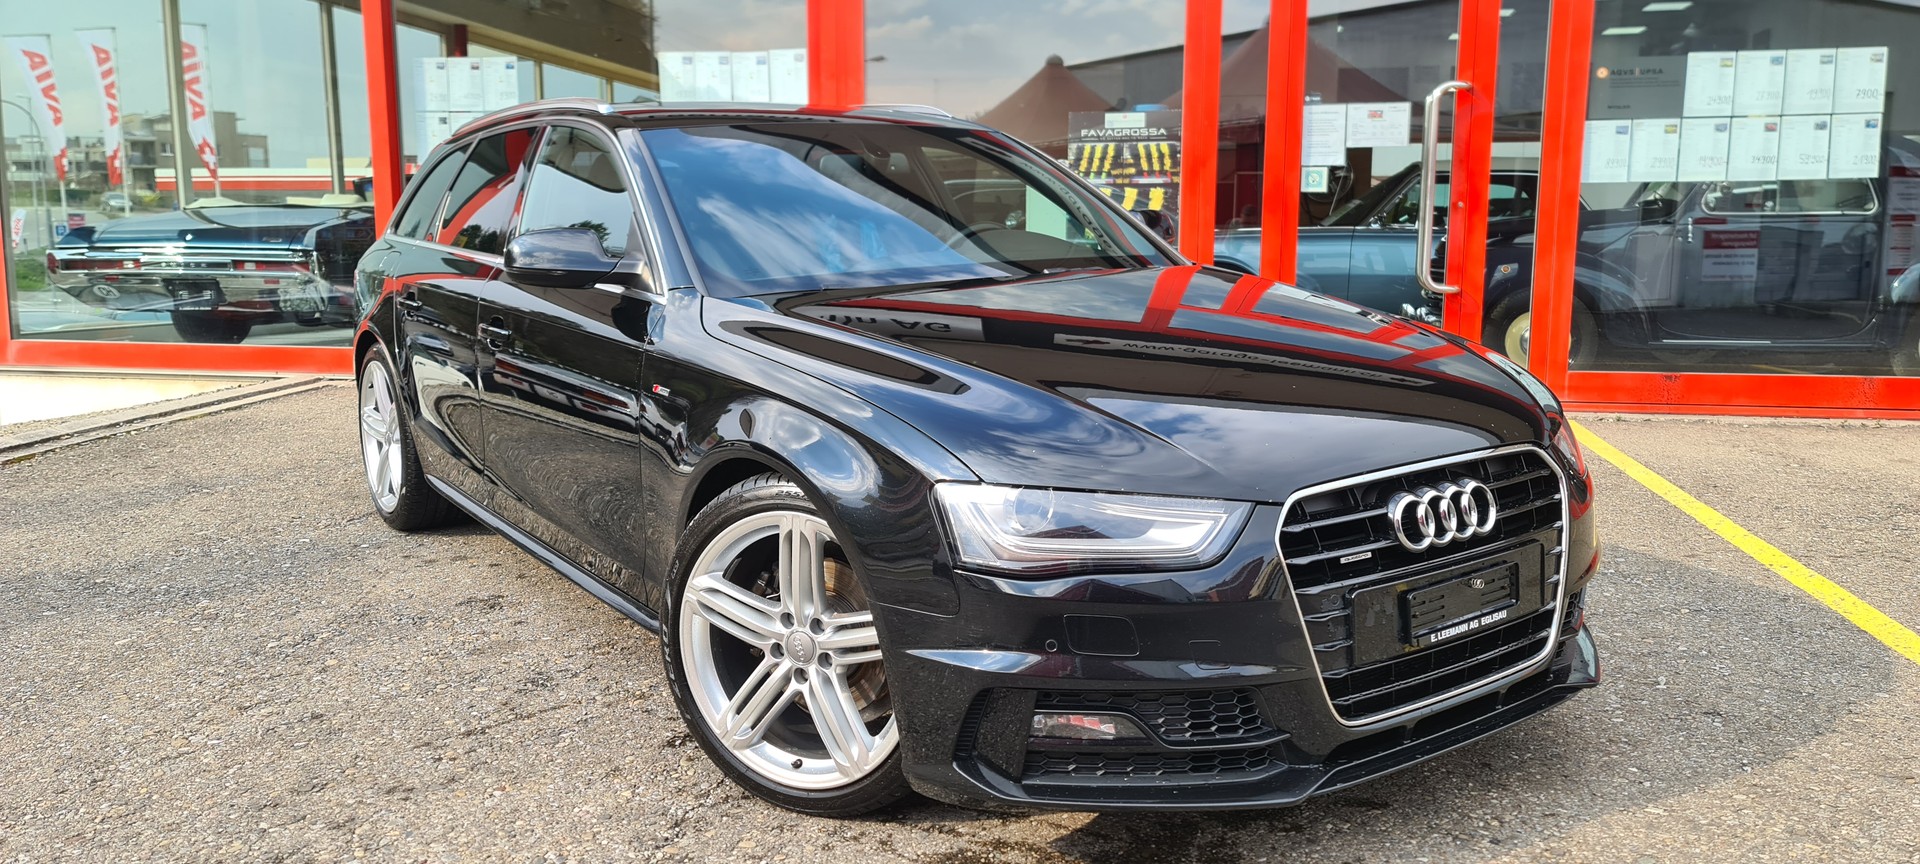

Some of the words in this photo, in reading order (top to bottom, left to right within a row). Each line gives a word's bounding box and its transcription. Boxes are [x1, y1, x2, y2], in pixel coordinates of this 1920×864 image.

[20, 48, 63, 127] AVIA
[91, 43, 119, 127] AVIA
[1080, 127, 1167, 137] FAVAGROSSA
[1438, 624, 1469, 641] LEEMANN
[1469, 621, 1479, 631] AG
[1481, 610, 1508, 626] EGLISAU
